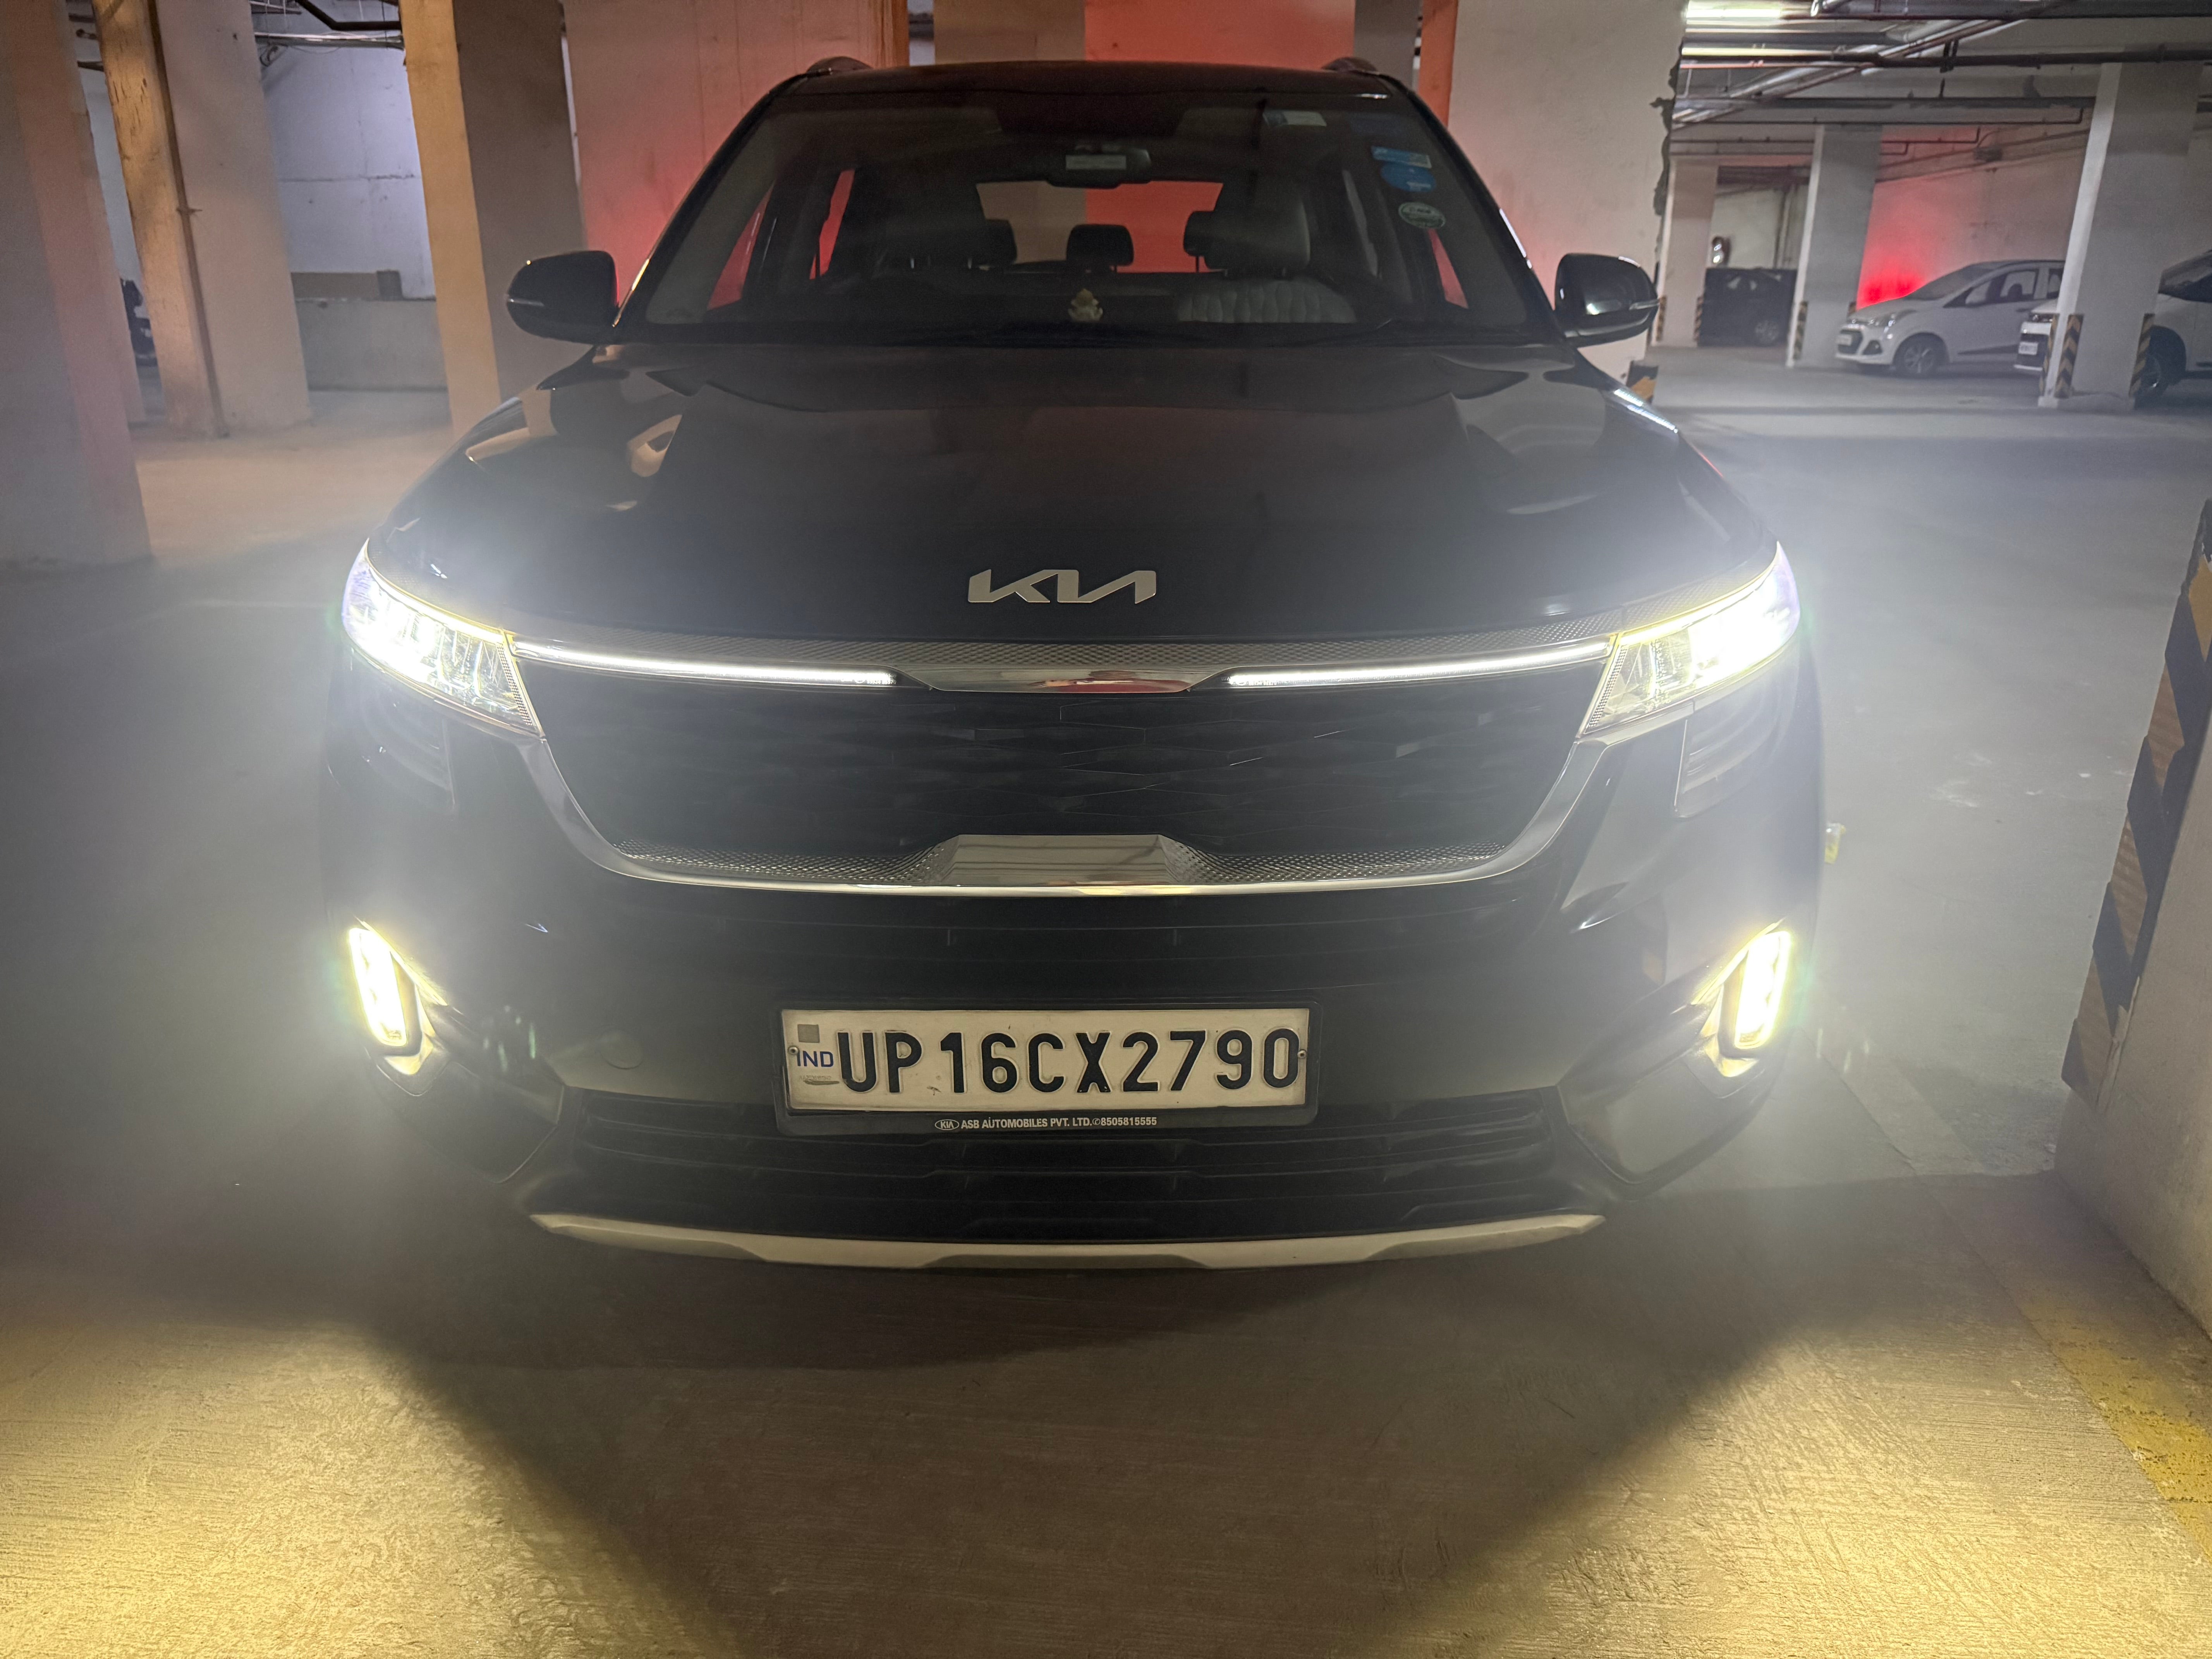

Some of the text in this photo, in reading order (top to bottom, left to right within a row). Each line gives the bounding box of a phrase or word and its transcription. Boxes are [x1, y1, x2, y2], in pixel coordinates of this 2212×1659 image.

[968, 569, 1156, 604] KIA
[797, 1050, 834, 1067] IND
[837, 1028, 1300, 1093] UP16CX2790
[961, 1120, 980, 1129] ASB
[982, 1118, 1048, 1128] AUTOMOBILES
[1050, 1118, 1070, 1127] PVT.
[1072, 1117, 1092, 1127] LTD.
[1101, 1117, 1157, 1126] 8505815555
